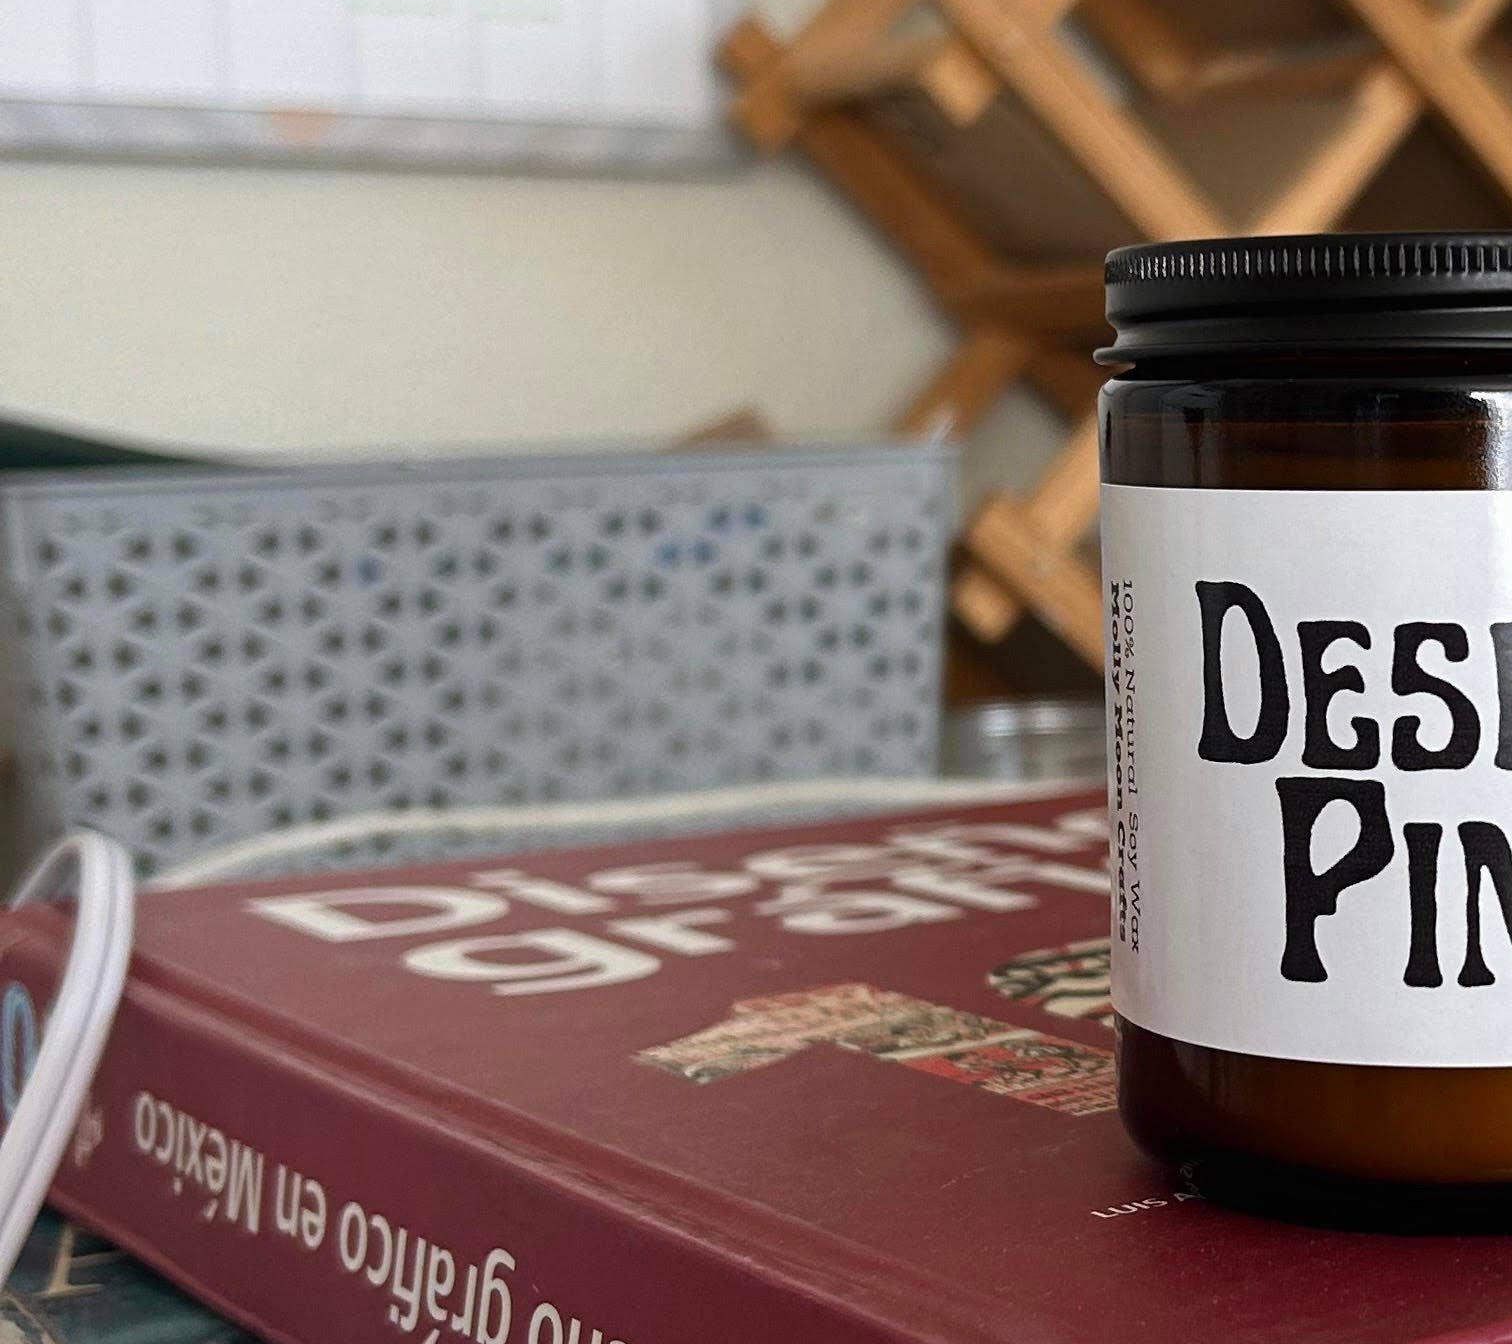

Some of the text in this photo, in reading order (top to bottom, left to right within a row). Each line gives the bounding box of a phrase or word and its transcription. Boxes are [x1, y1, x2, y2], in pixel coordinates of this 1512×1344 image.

[1111, 581, 1127, 943] Molly Moon Crafts
[1123, 580, 1142, 954] 100% Natural Soy Wax
[134, 1090, 265, 1236] México
[275, 1162, 327, 1250] en
[1090, 1197, 1168, 1219] LUIS
